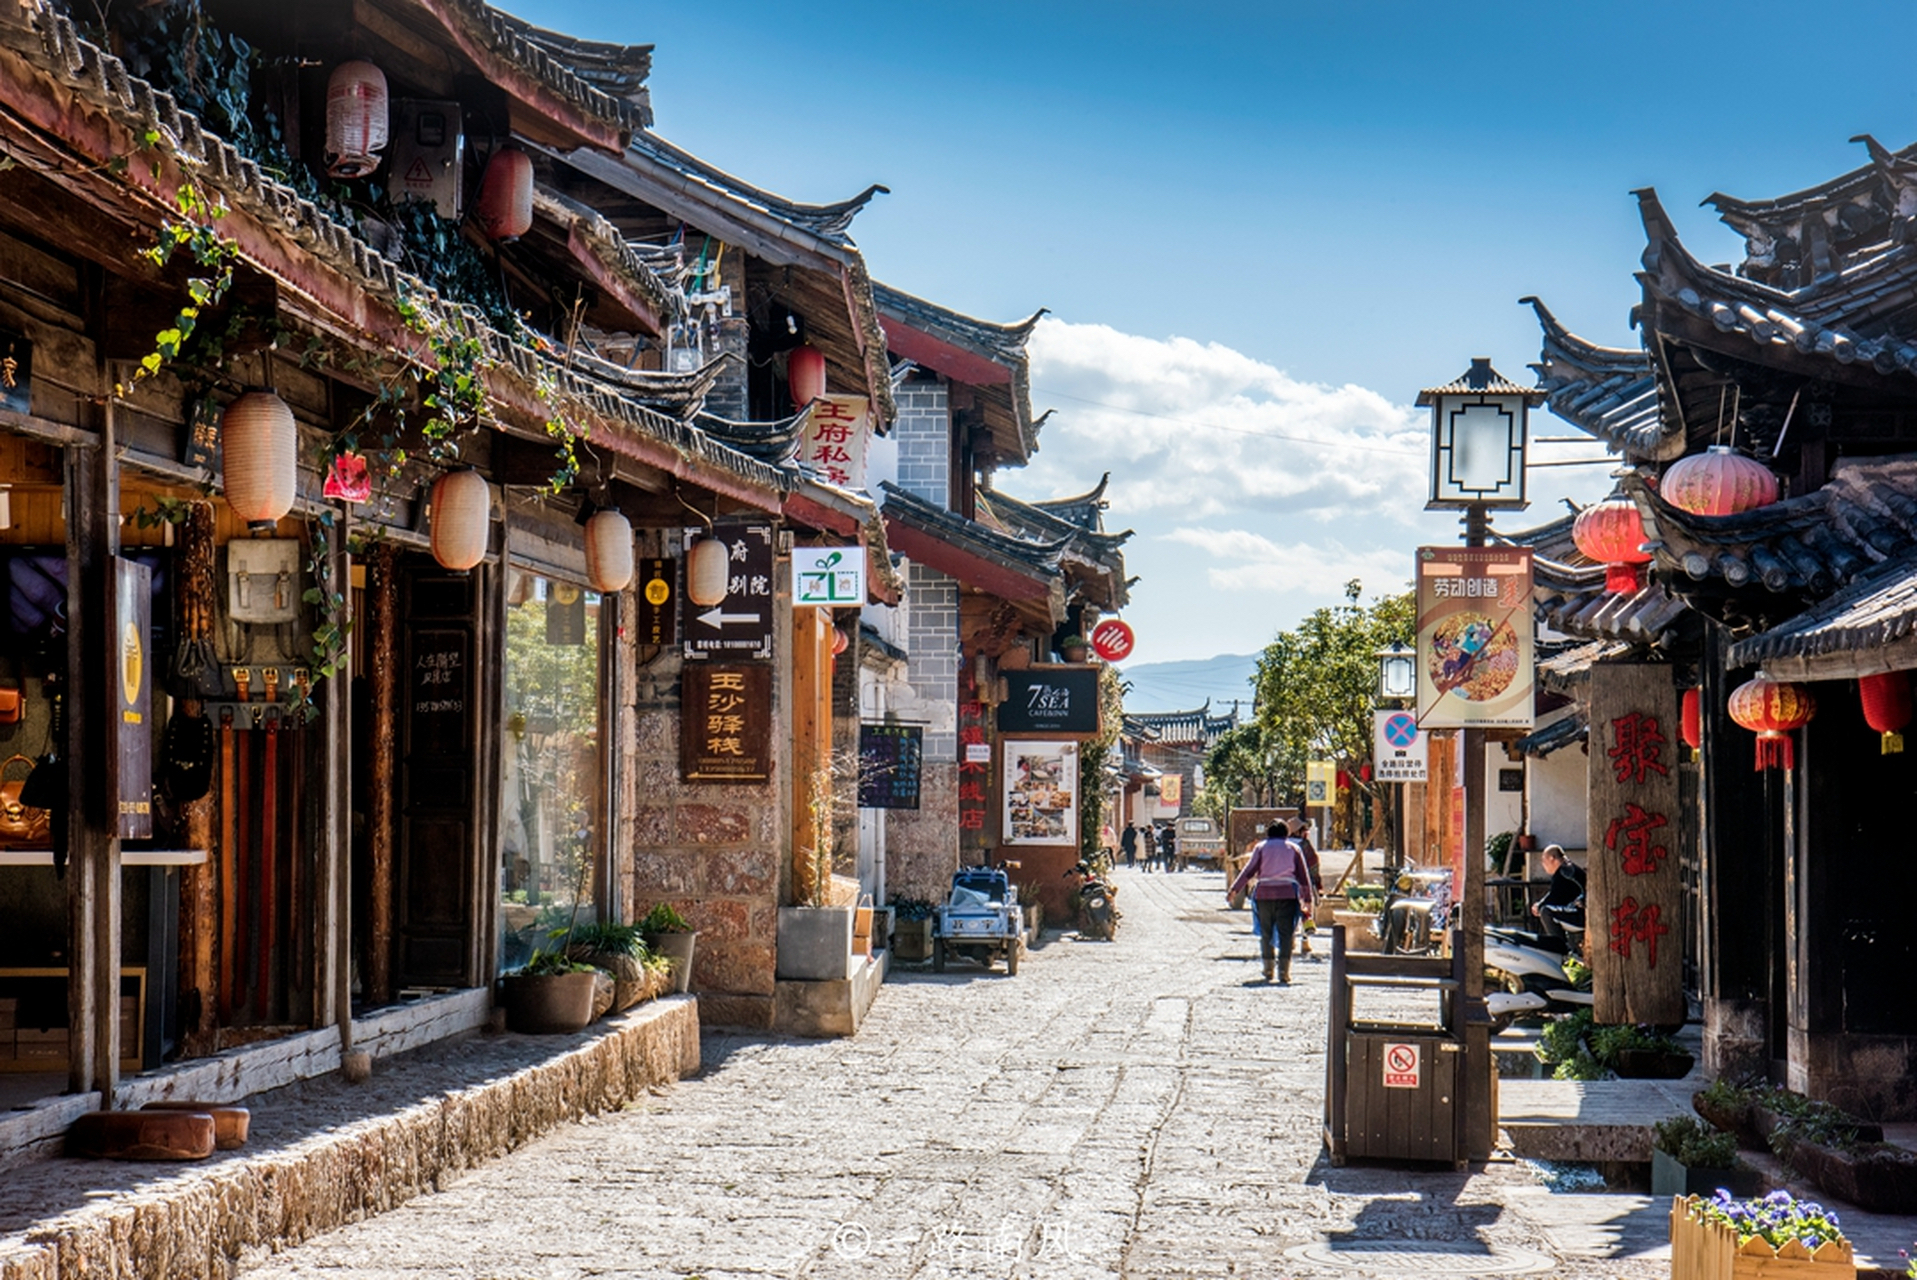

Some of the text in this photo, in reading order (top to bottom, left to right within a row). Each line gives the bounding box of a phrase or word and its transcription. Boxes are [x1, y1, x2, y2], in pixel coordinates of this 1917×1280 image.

[730, 539, 749, 563] 府
[728, 574, 770, 597] 别院
[1434, 577, 1498, 598] 劳动创造
[1096, 626, 1129, 655] illy
[1027, 684, 1043, 709] 7
[1038, 695, 1070, 709] SEA
